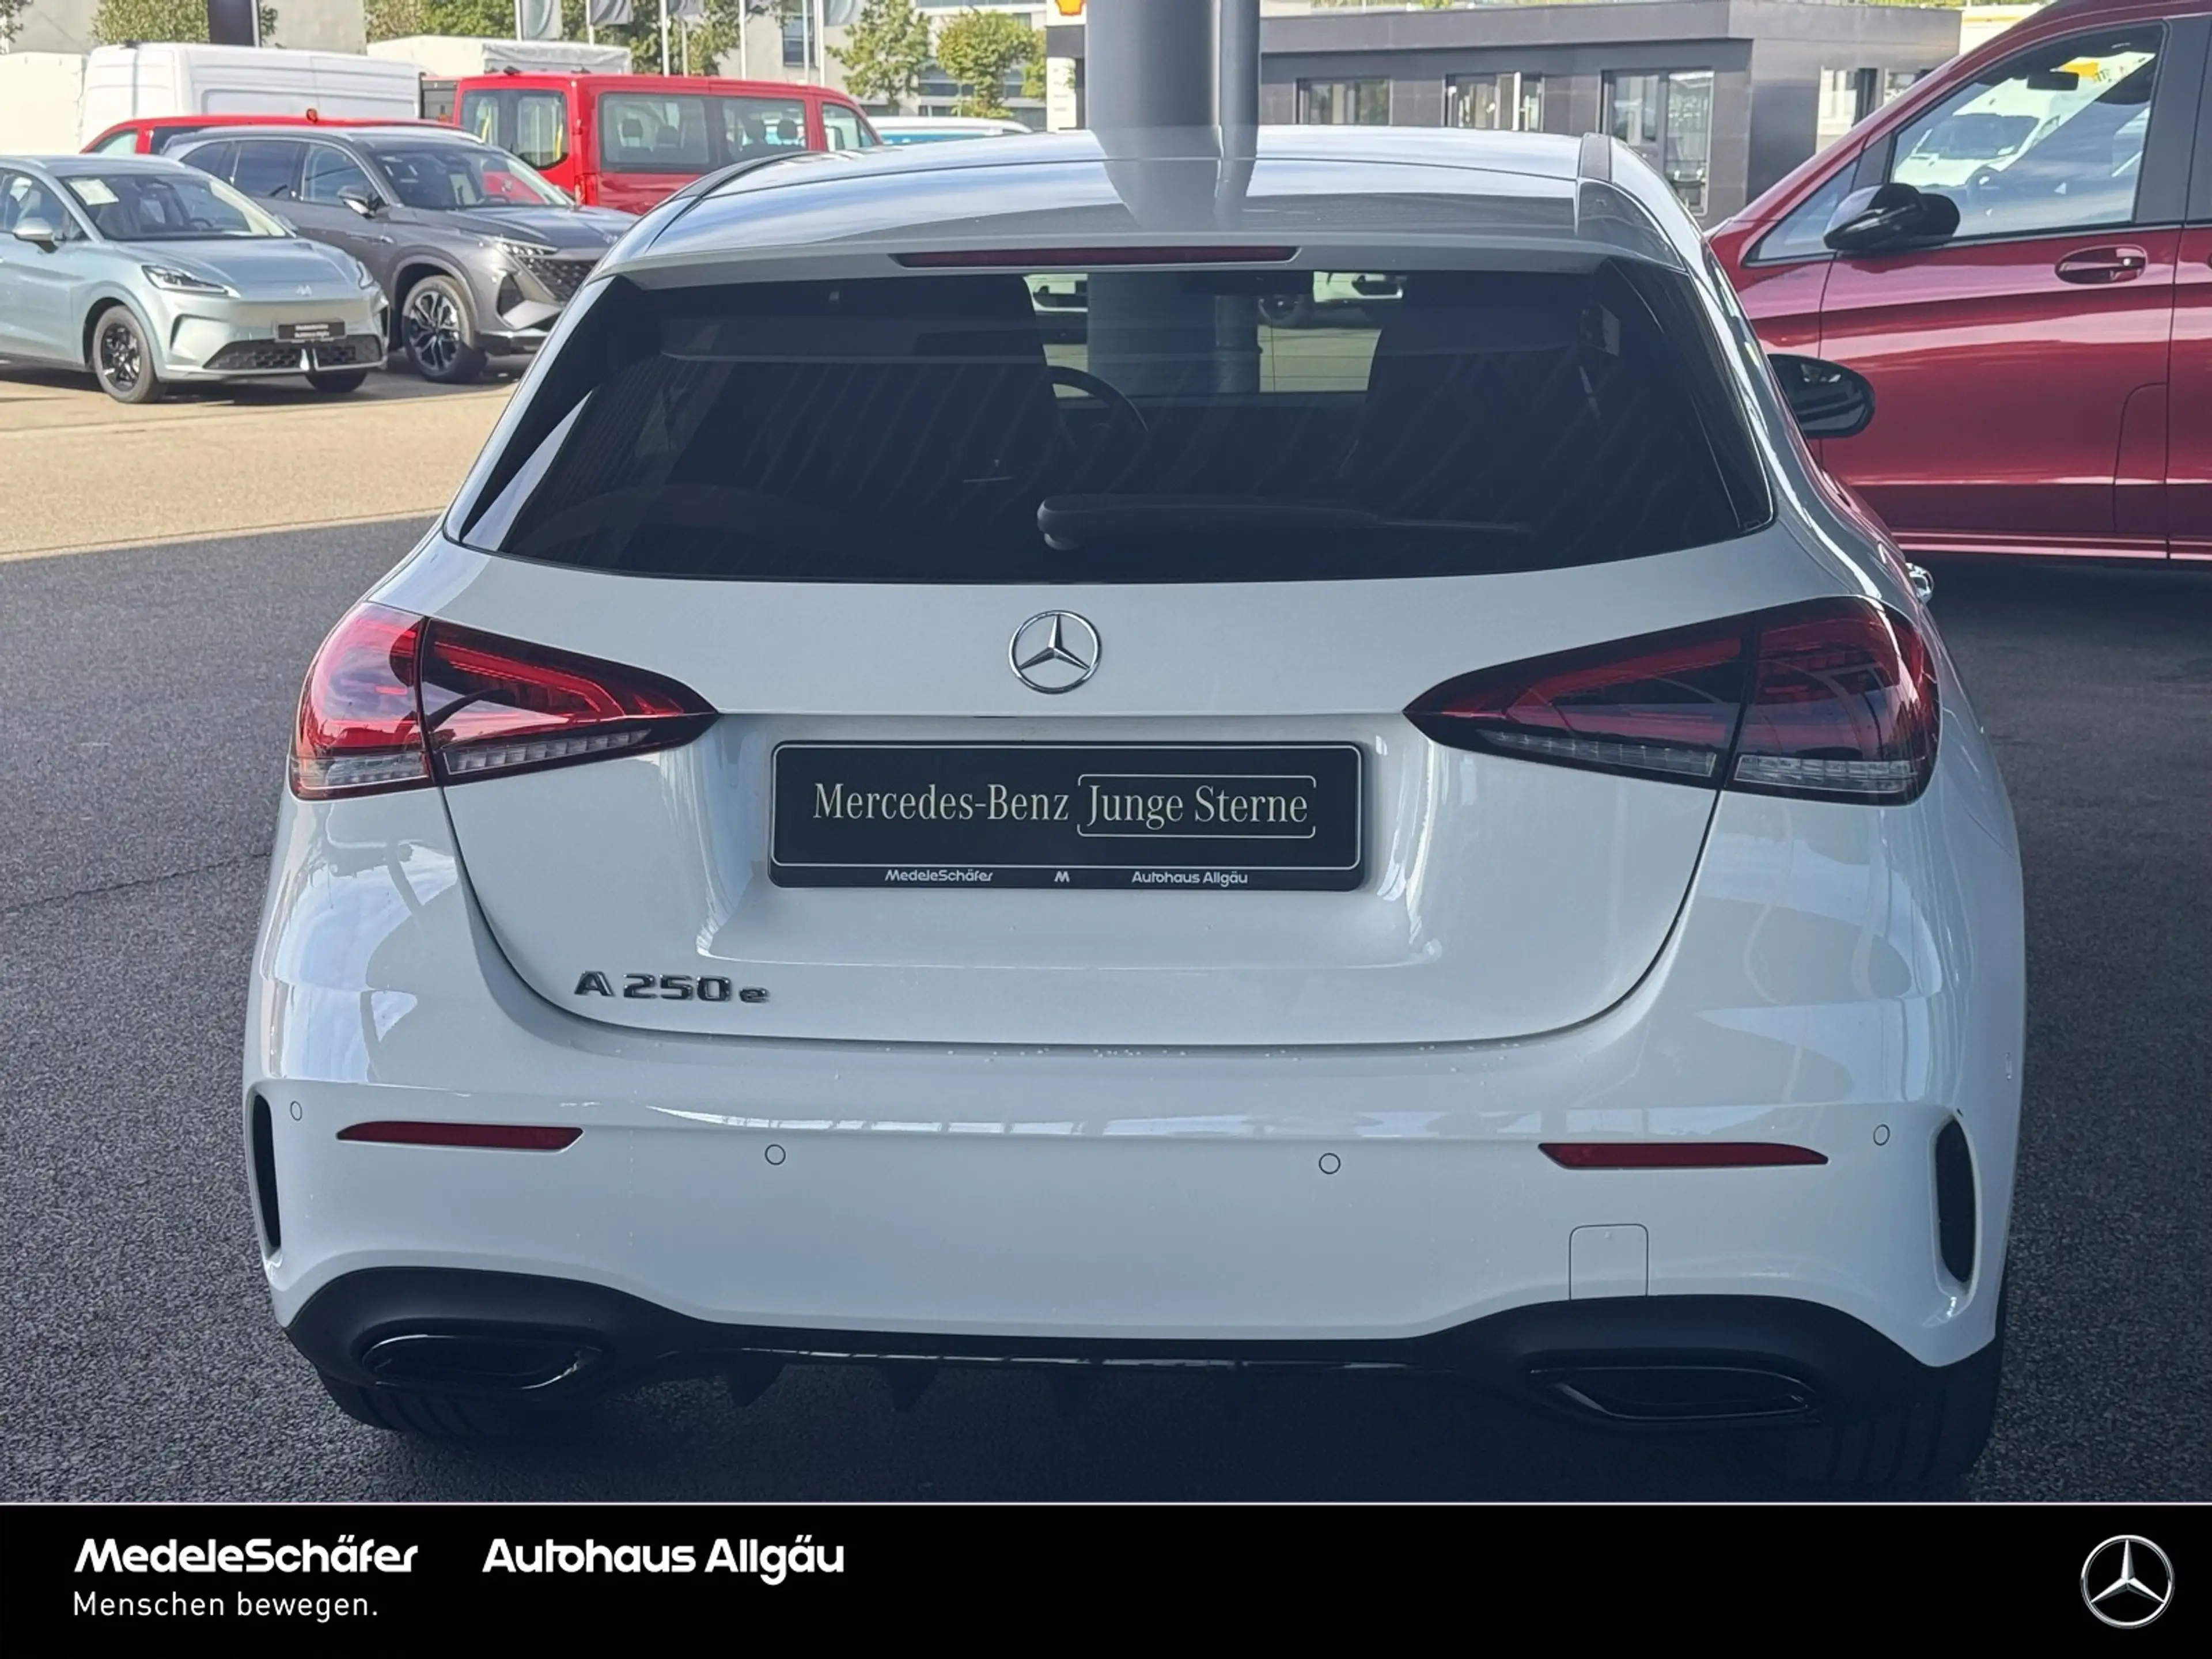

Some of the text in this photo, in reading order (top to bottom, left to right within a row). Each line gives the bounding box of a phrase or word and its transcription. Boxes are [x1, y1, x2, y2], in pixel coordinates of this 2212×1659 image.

[812, 783, 1308, 830] Mercedes-Benz Junge Sterne
[885, 869, 994, 882] MedeleSchäfer
[1131, 870, 1248, 888] Autohaus Allgäu
[574, 971, 769, 1003] A 250 e
